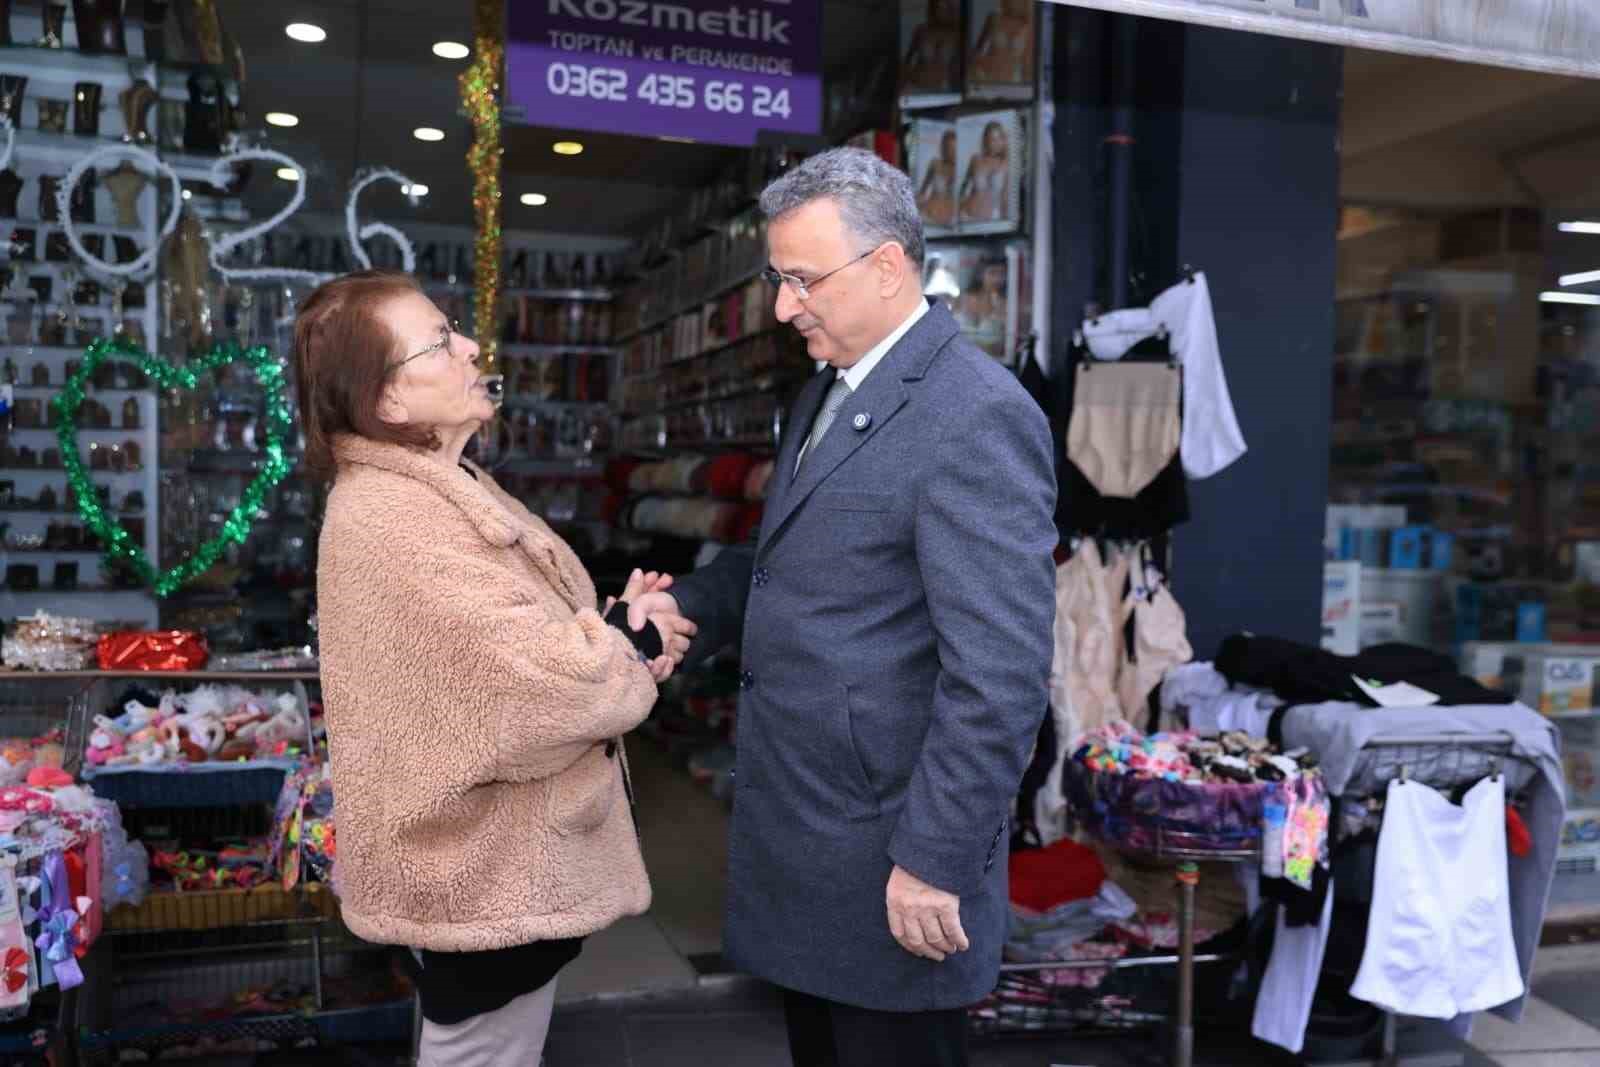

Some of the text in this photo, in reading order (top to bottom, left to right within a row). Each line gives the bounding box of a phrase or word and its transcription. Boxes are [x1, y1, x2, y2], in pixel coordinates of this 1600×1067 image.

[548, 29, 634, 57] TOPTAN
[672, 45, 792, 76] PERAKENDE
[547, 62, 791, 118] 0362 435 66 24
[0, 112, 420, 280] 026
